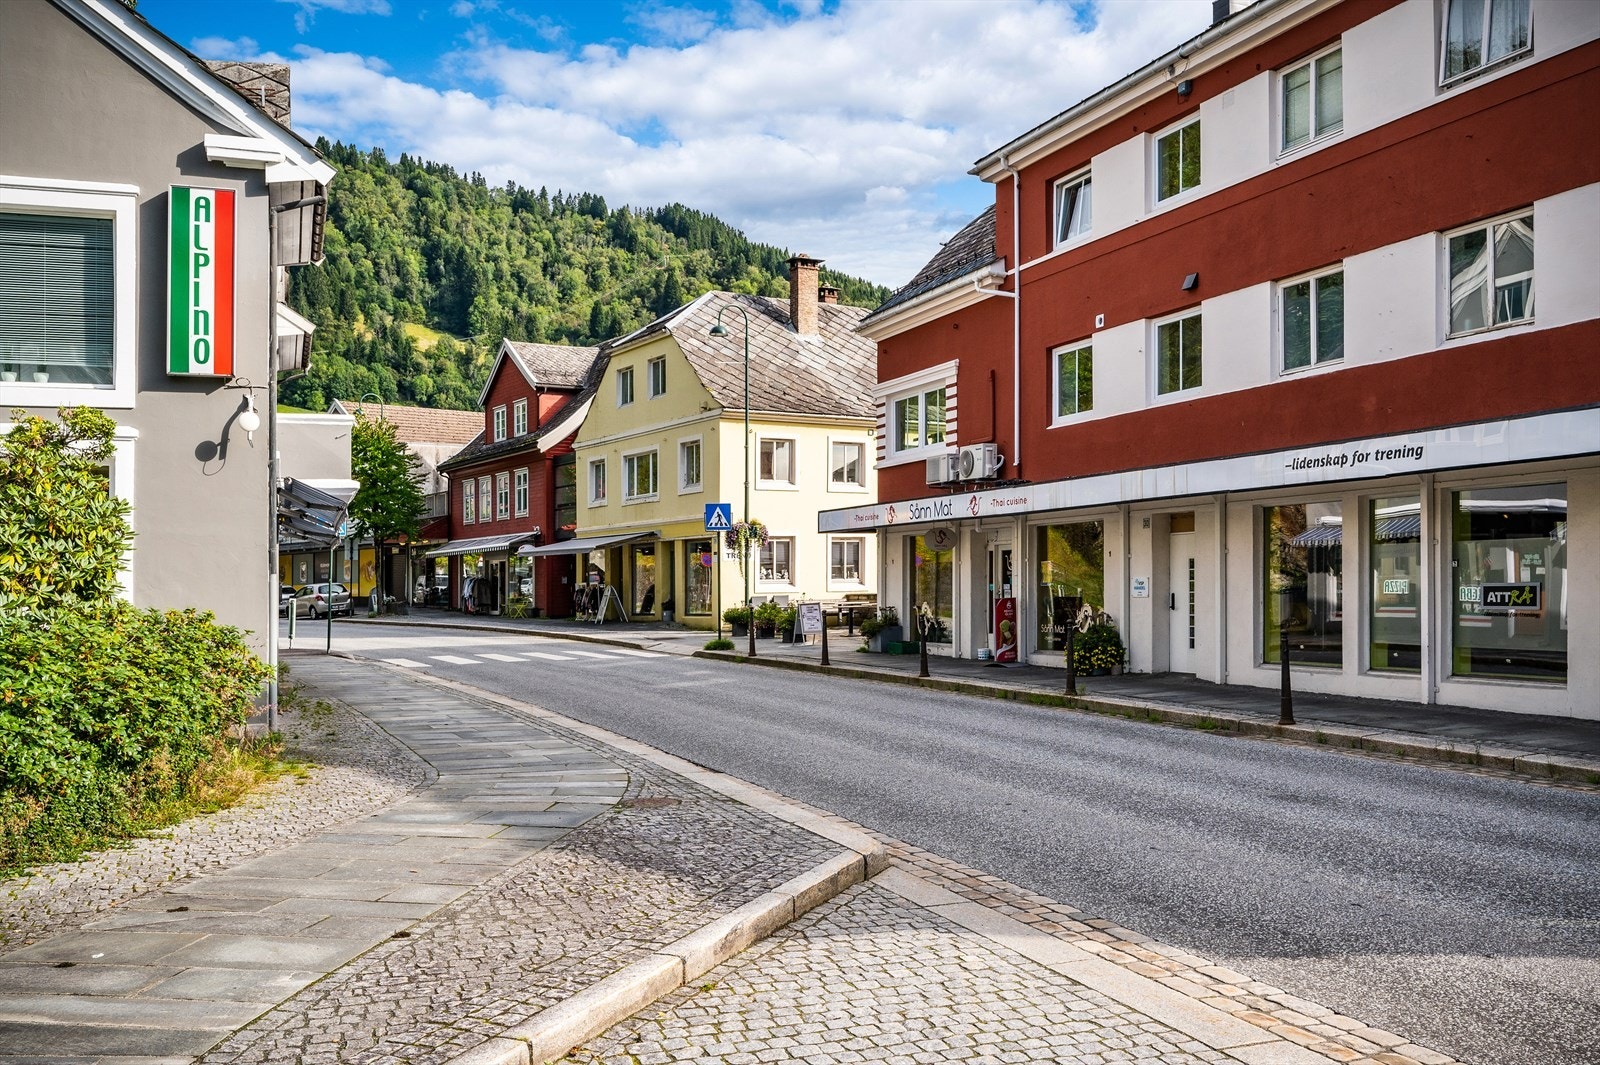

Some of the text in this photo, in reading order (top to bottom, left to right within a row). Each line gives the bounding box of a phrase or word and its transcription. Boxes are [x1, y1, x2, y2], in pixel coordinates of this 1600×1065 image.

[1350, 450, 1371, 467] for
[1374, 445, 1424, 461] trening
[909, 499, 953, 520] Sånn Mat
[1006, 496, 1028, 506] cuisine
